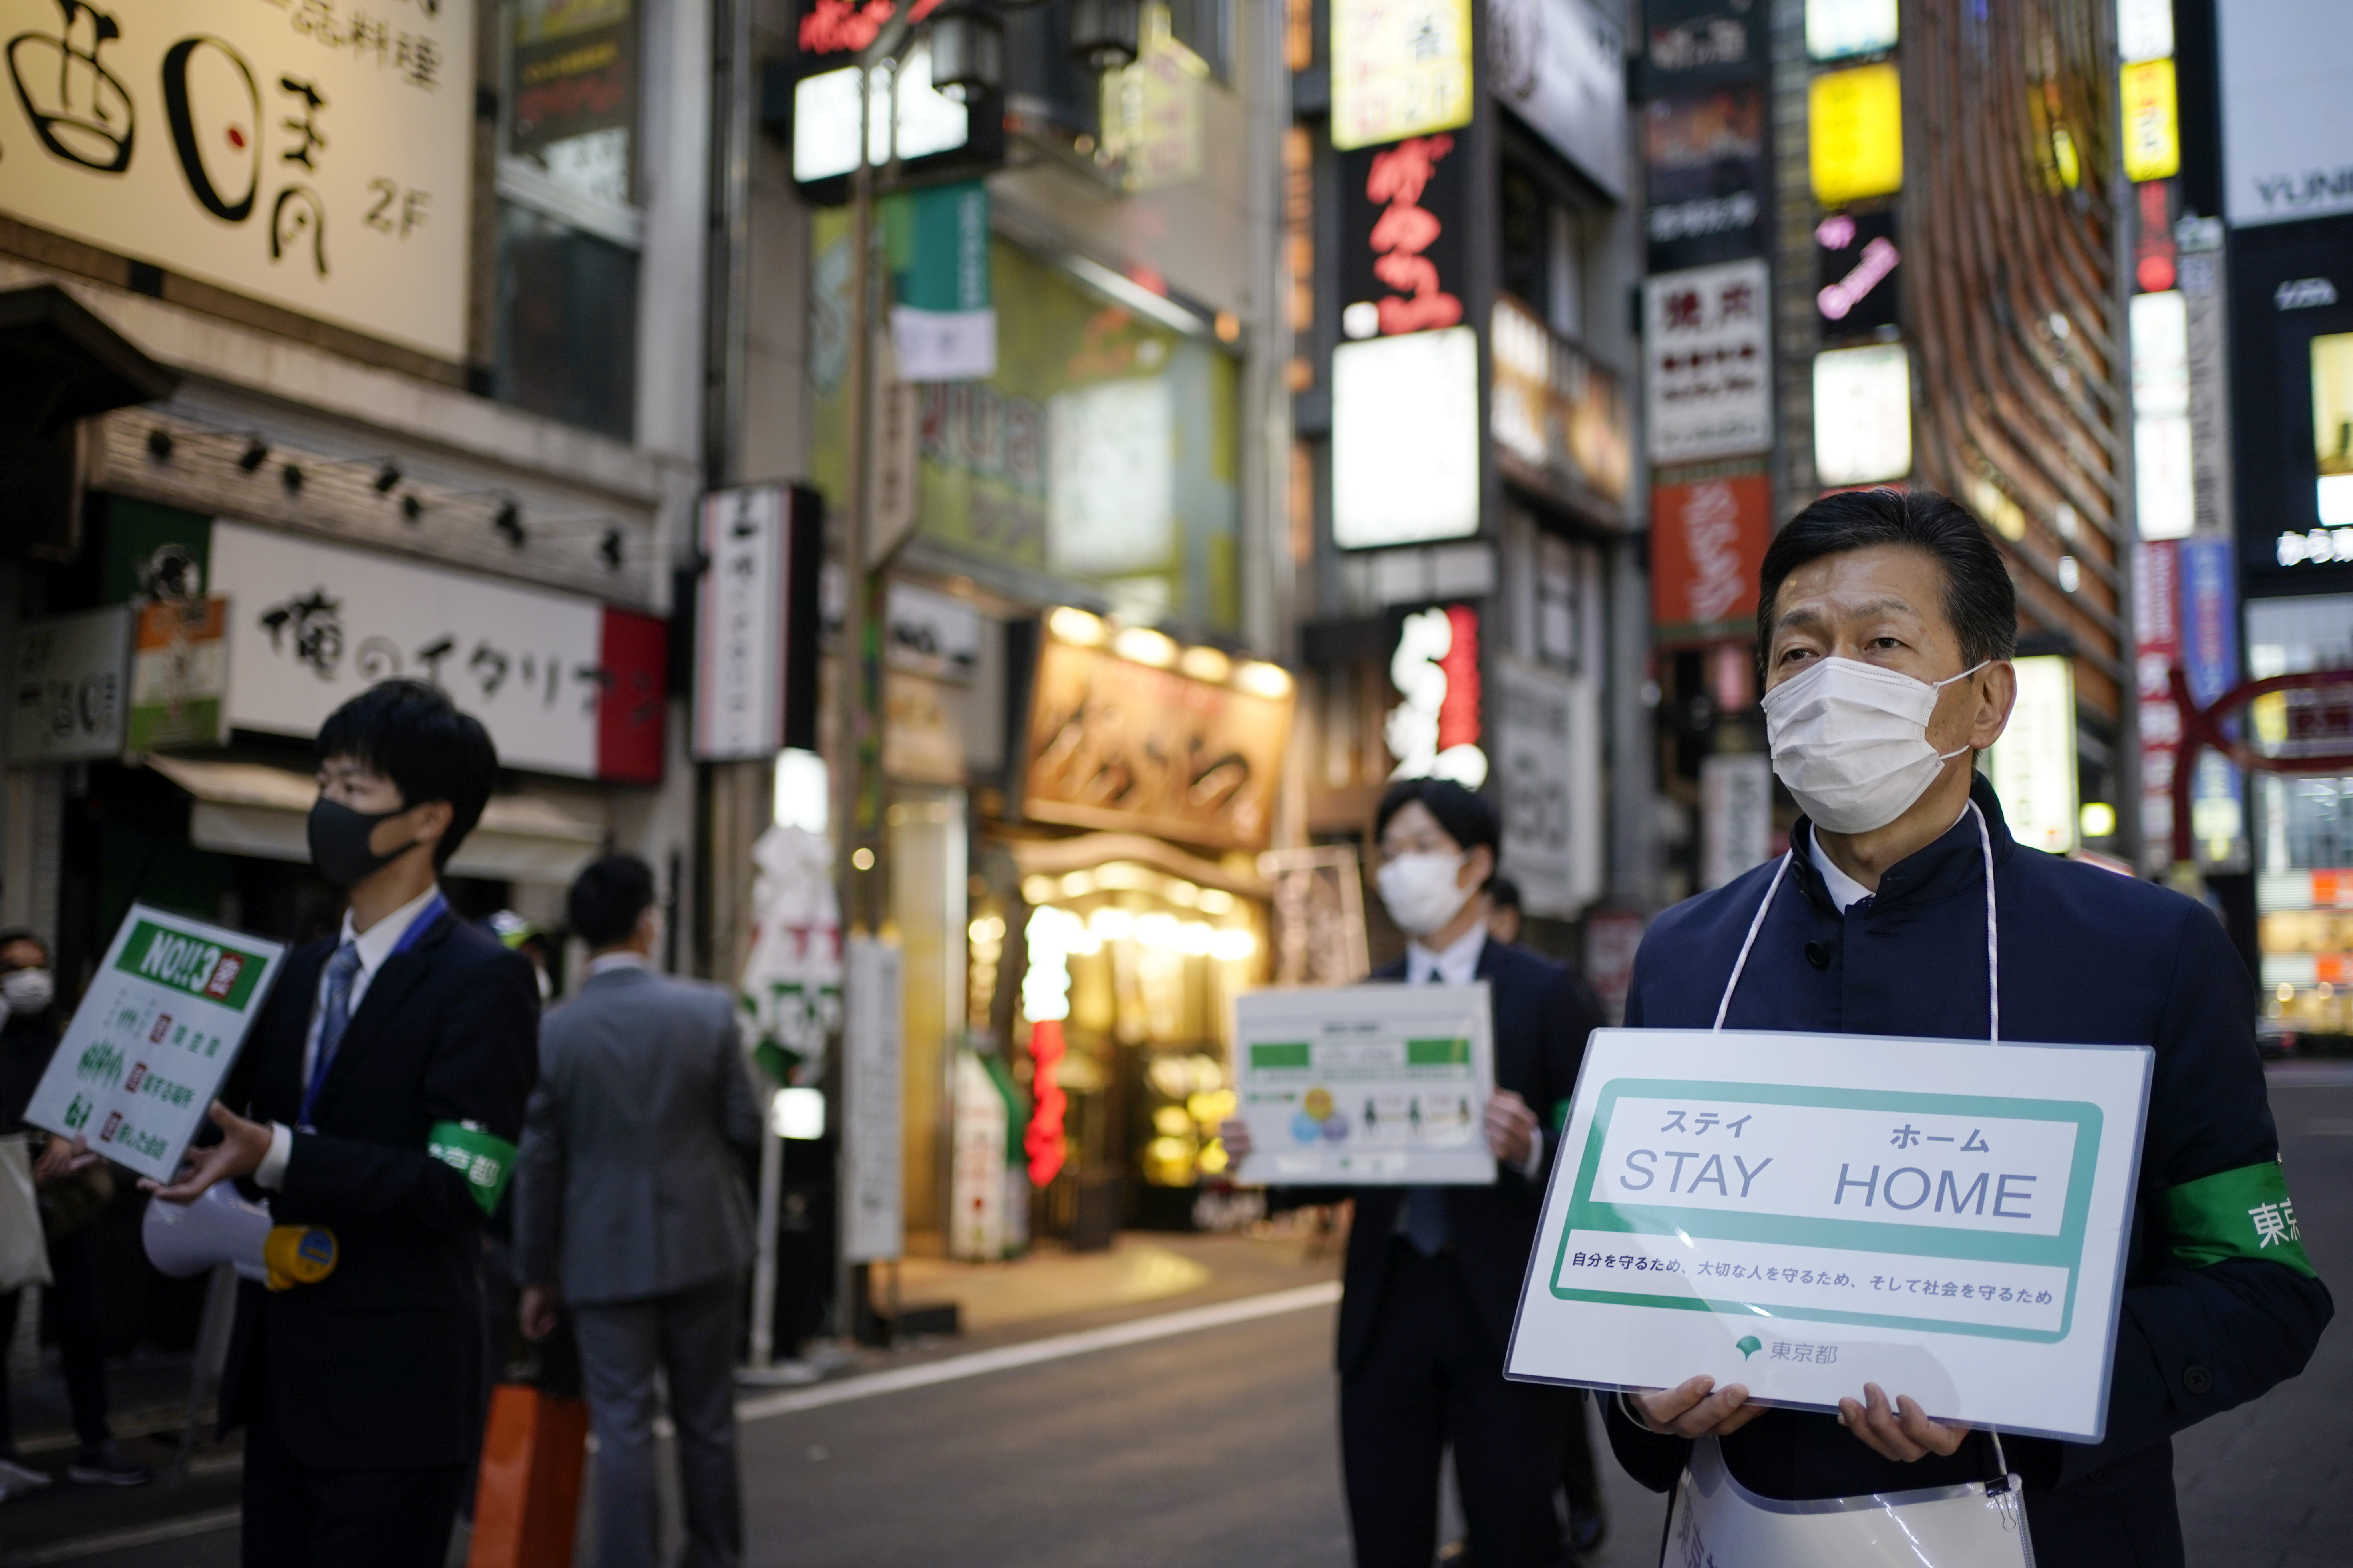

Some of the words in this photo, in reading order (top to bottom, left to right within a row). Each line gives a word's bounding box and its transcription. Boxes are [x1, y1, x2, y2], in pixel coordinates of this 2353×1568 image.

[363, 176, 434, 240] 2F
[1661, 1110, 1752, 1138] ステイ
[1890, 1124, 1990, 1153] ホーム
[1620, 1149, 1774, 1198] STAY
[1834, 1163, 2037, 1219] HOME
[1770, 1341, 1838, 1365] 東京都
